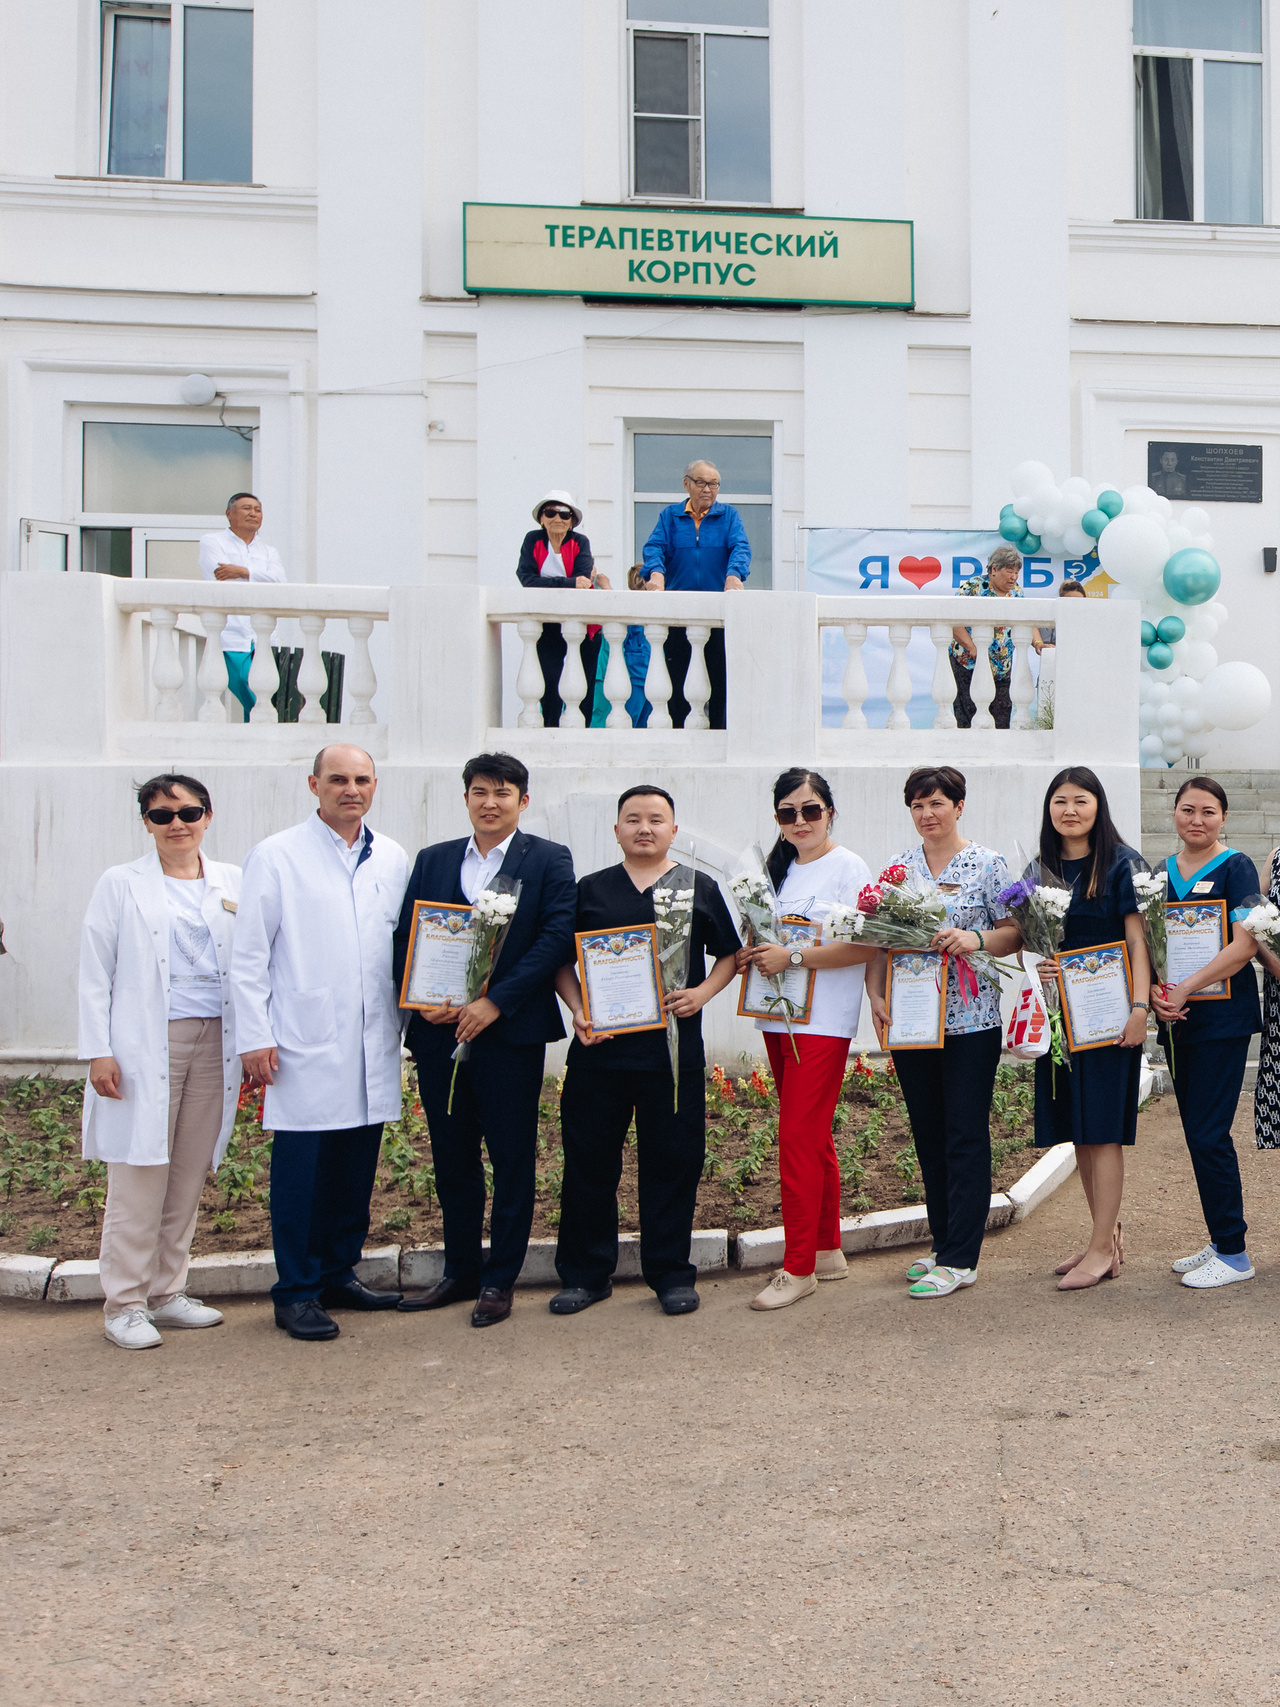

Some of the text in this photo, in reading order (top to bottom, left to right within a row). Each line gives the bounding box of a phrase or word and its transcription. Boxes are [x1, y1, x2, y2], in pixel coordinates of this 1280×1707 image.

[545, 224, 838, 258] ТЕРАПЕВТИЧЕСКИЙ
[628, 259, 756, 286] КОРПУС
[859, 556, 1054, 589] Я РБ
